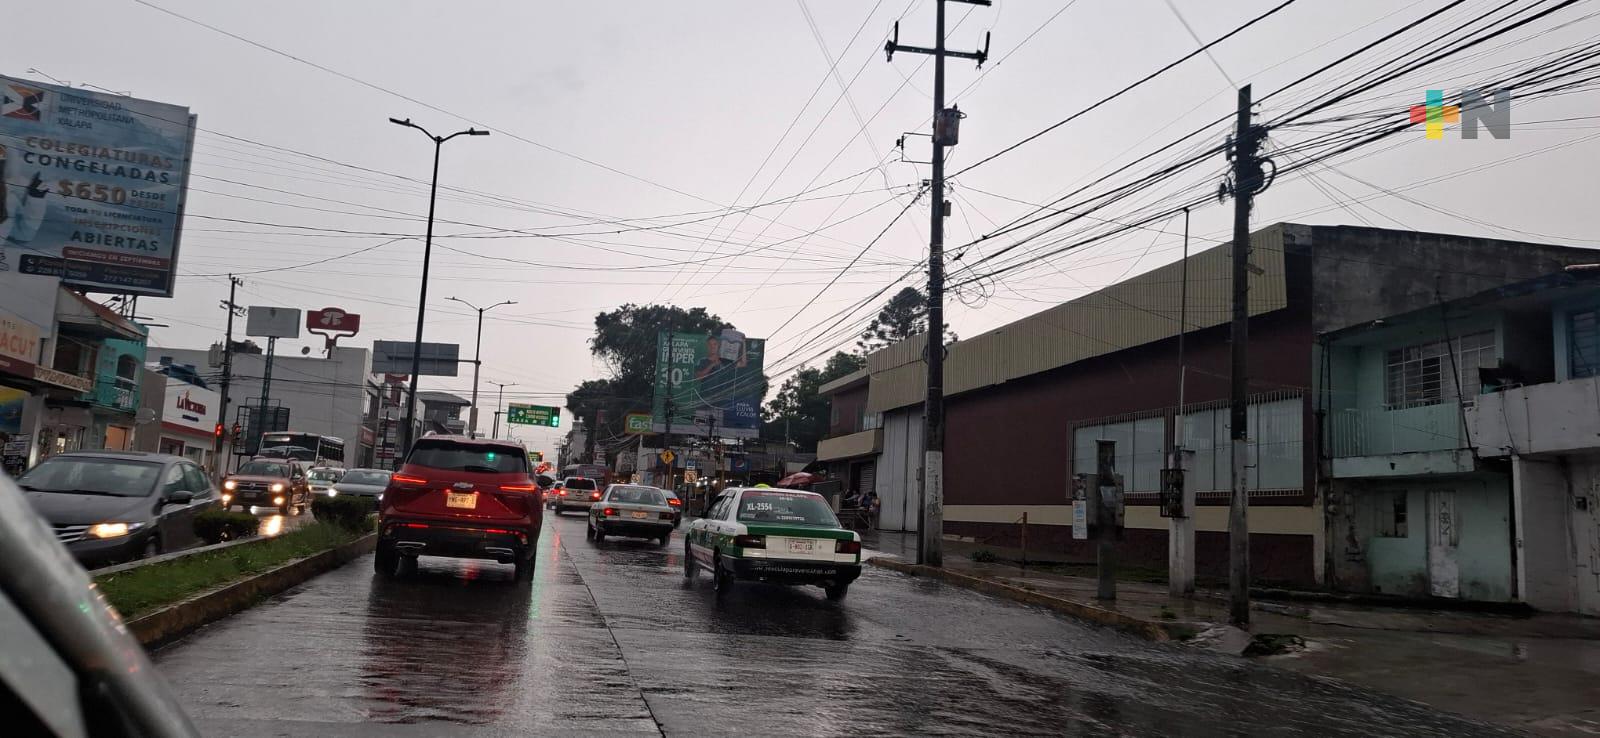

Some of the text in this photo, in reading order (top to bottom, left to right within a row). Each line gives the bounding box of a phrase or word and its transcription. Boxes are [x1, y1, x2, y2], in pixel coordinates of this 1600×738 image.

[58, 105, 134, 125] METROPOLITANA
[58, 118, 92, 129] XALAPA
[25, 136, 173, 169] COLEGIATURAS
[23, 151, 169, 184] CONGELADAS
[58, 179, 126, 205] $650
[131, 189, 167, 201] DESDE
[64, 205, 88, 214] TODA
[103, 210, 163, 224] LICENCIATURA
[71, 230, 159, 252] ABIERTAS
